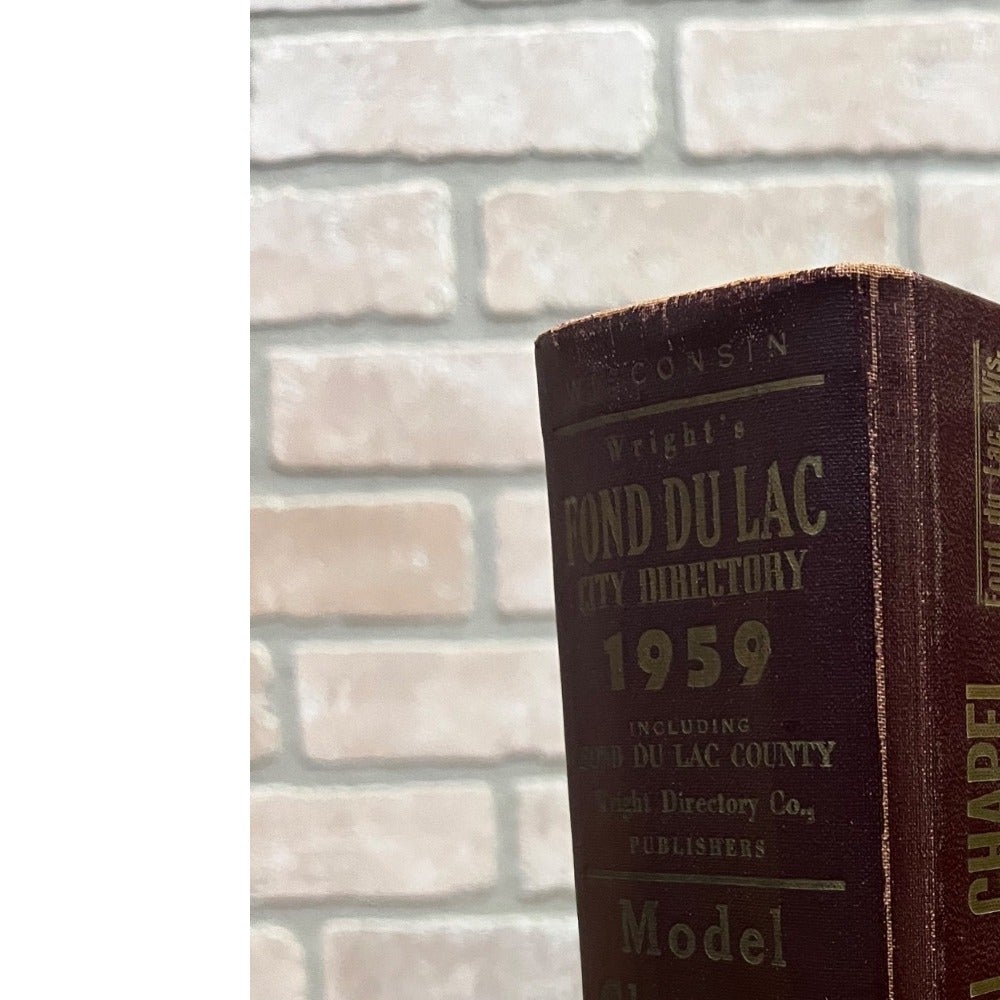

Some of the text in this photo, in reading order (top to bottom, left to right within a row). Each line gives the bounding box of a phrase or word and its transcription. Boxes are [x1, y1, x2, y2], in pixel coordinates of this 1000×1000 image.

[606, 413, 745, 461] Wright's
[564, 454, 828, 567] FOND DU LAC
[578, 549, 808, 617] CITY DIRECTORY
[603, 619, 773, 692] 1959
[629, 717, 751, 737] INCLUDING
[633, 742, 664, 769] DU
[672, 742, 720, 769] LAC
[730, 740, 837, 769] COUNTY
[661, 788, 758, 823] Directory
[629, 836, 766, 859] PUBLISHERS
[619, 899, 788, 968] Model
